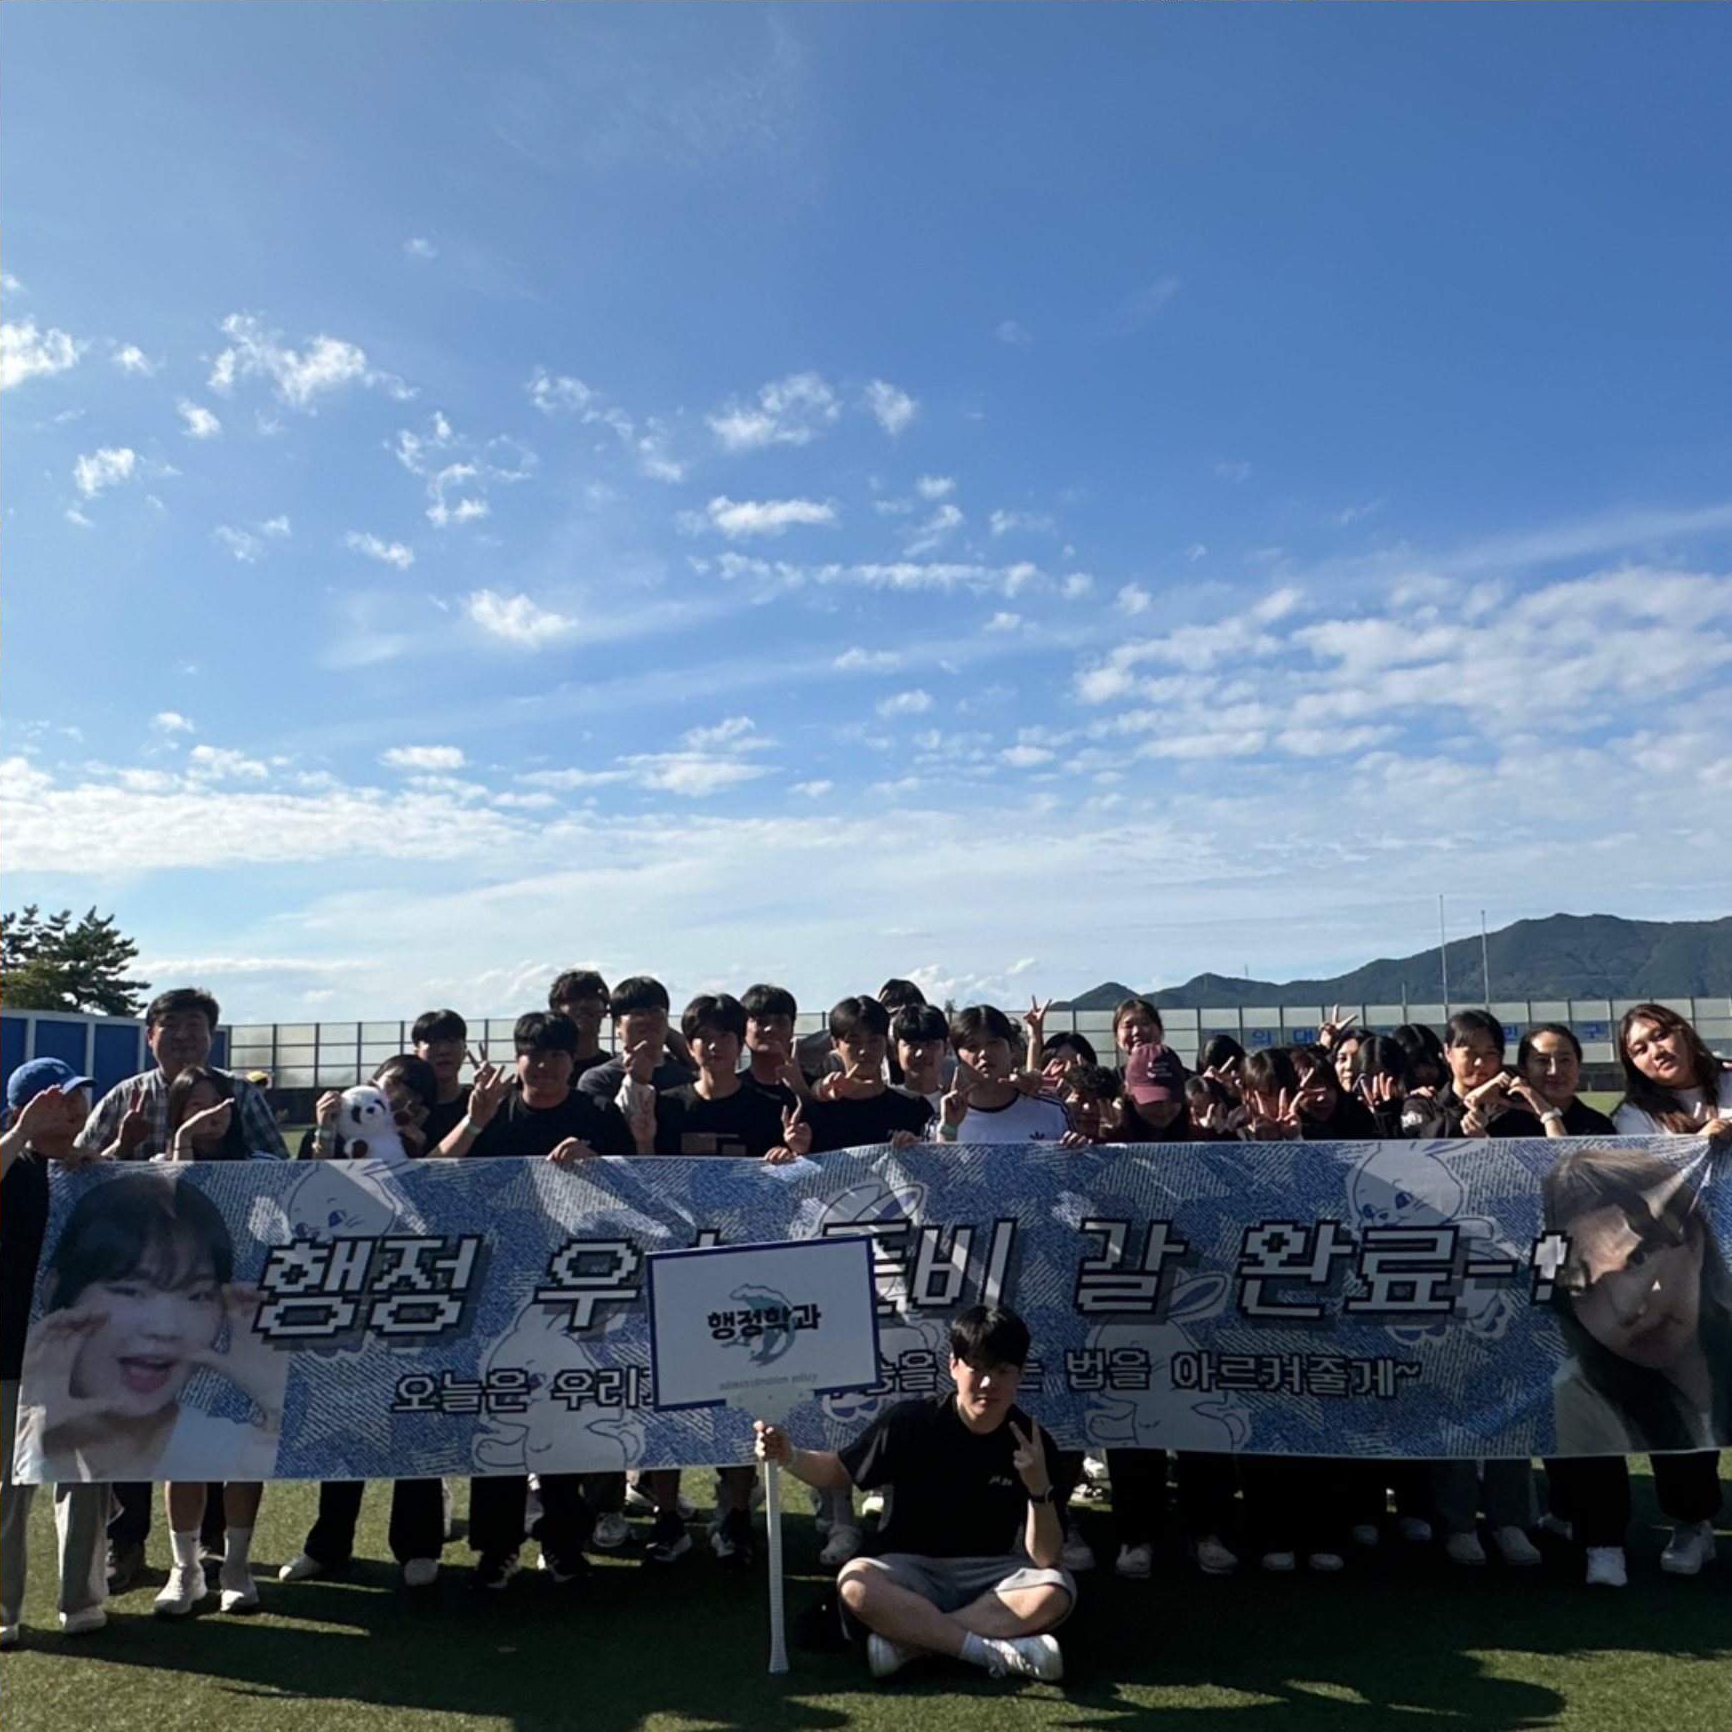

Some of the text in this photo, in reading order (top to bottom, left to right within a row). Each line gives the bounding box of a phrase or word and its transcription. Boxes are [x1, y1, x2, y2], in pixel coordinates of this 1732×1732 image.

[252, 1234, 484, 1340] 행정
[707, 1303, 821, 1341] 행정학과
[390, 1368, 532, 1414] 오늘은
[550, 1364, 654, 1412] 우리
[1065, 1347, 1151, 1391] 법을
